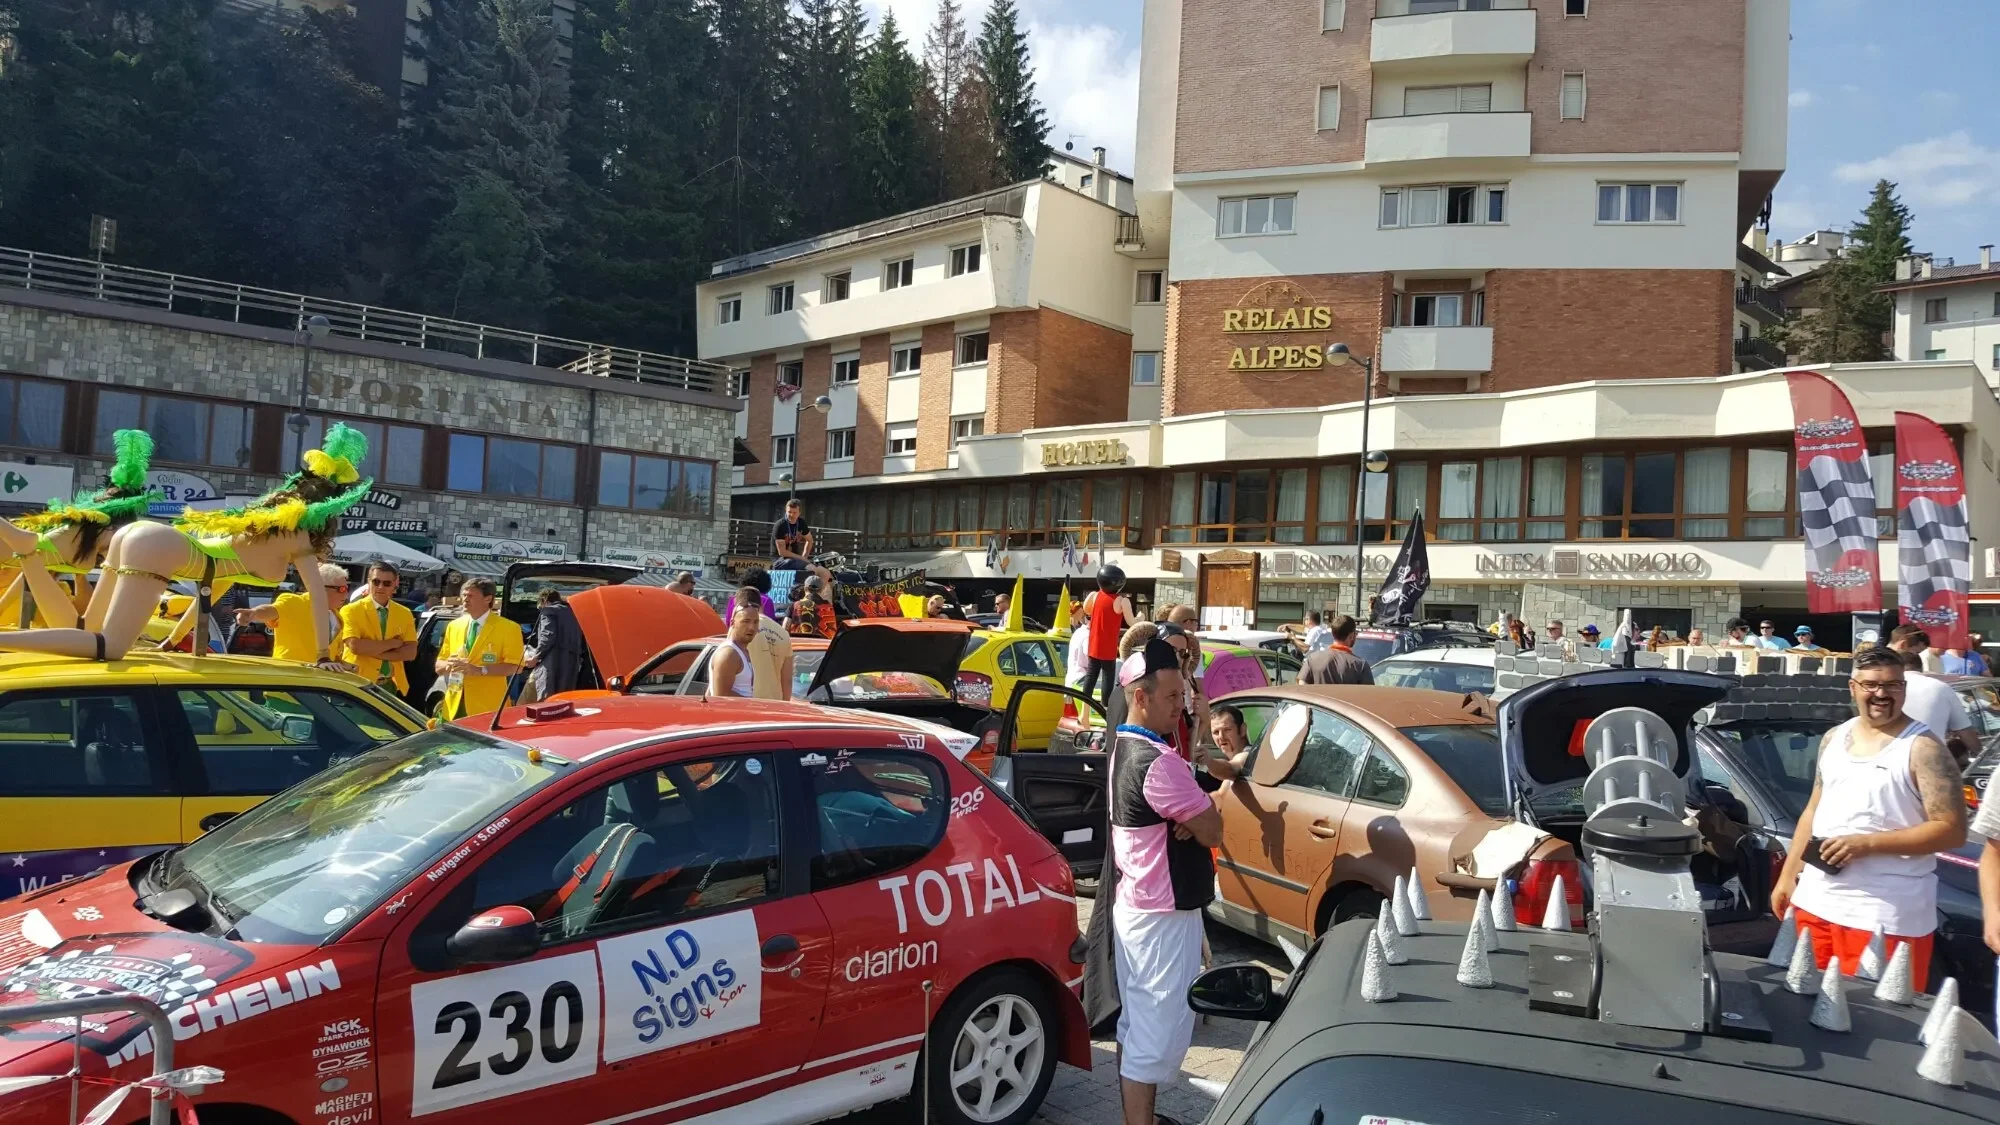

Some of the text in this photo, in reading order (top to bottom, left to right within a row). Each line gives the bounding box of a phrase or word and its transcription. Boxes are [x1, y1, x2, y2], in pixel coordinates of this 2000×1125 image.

[1223, 306, 1331, 331] RELAIS
[1228, 345, 1322, 368] ALPES
[1040, 438, 1127, 466] HOTEL
[364, 490, 398, 508] TINA
[346, 520, 368, 529] OFF
[1475, 551, 1701, 573] INTESA SANPAOLO
[769, 571, 796, 589] OSTATE
[951, 786, 984, 814] 206
[956, 803, 979, 819] WRC
[427, 846, 471, 881] Navigator
[478, 817, 511, 841] S.Glen
[878, 854, 1040, 933] TOTAL
[632, 929, 700, 996] N.D
[845, 940, 938, 982] clarion
[40, 966, 120, 983] Wacky
[633, 959, 736, 1044] Signs
[719, 984, 747, 1008] Son
[318, 1027, 370, 1043] SPARK PLUGS
[324, 1018, 361, 1036] NGK
[431, 980, 584, 1090] 230
[312, 1037, 370, 1057] DYNAWORK
[327, 1107, 373, 1125] devil
